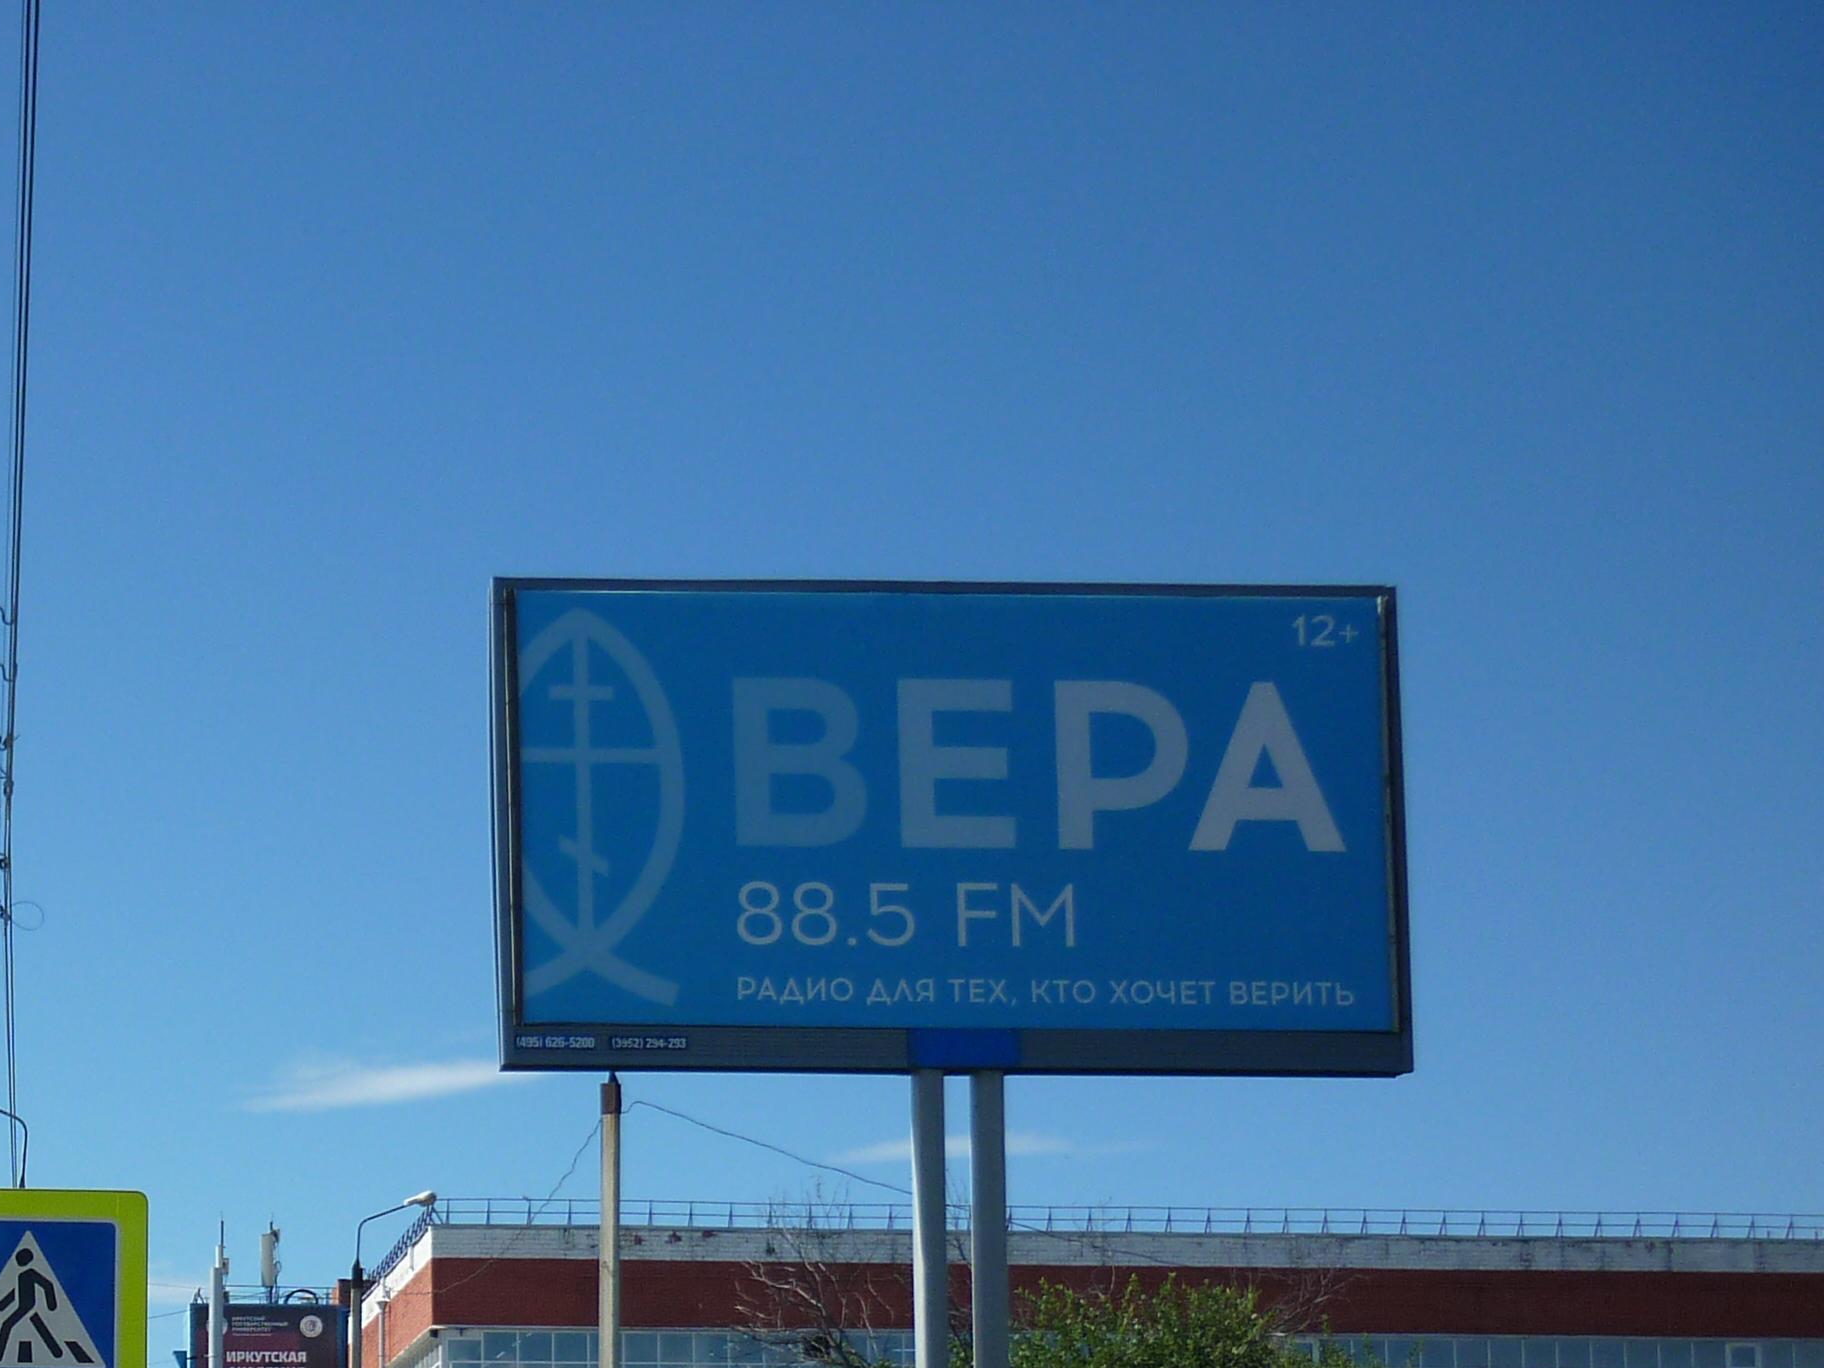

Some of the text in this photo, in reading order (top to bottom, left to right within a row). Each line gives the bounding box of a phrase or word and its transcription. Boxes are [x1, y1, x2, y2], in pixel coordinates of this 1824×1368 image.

[1292, 614, 1359, 647] 12+
[732, 676, 1347, 853] ВЕРА
[736, 880, 1077, 948] 88.5 FM
[736, 976, 1355, 1007] РАДИО ДЛЯ ТЕХ, КТО ХОЧЕТ ВЕРИТЬ
[226, 1351, 307, 1363] ИРКУТСКАЯ
